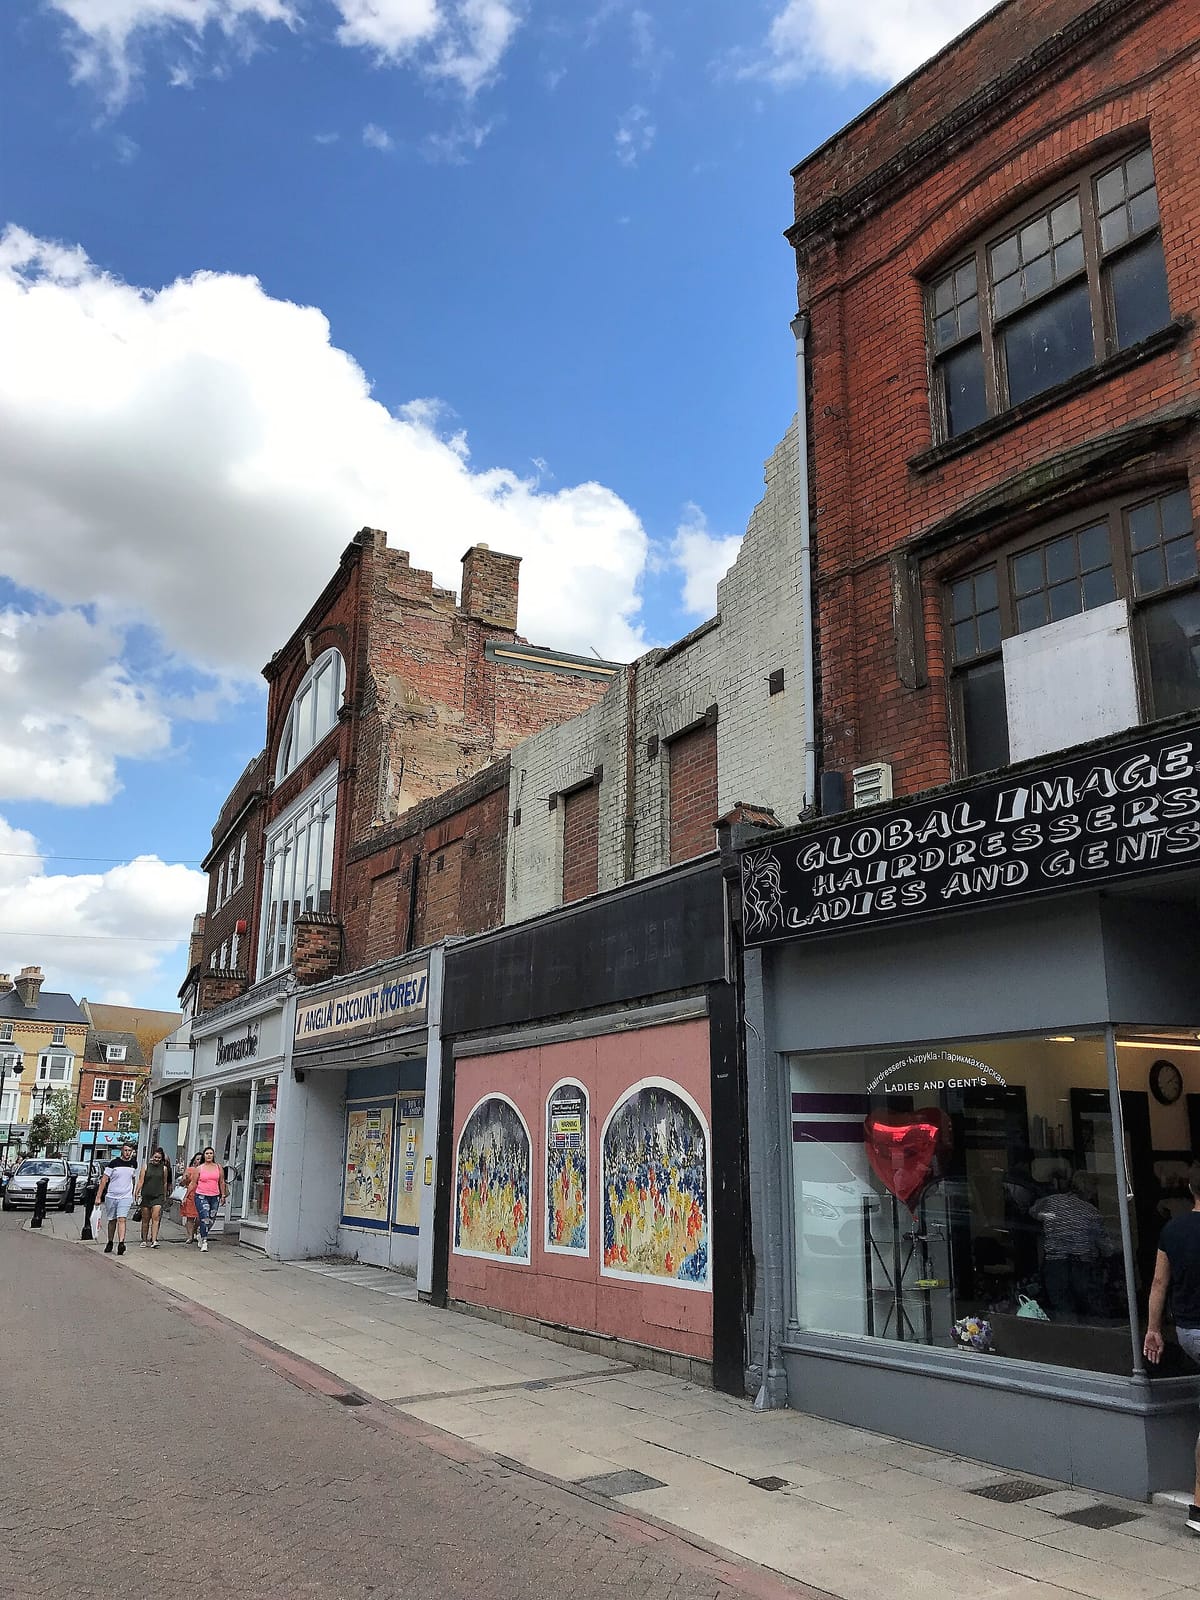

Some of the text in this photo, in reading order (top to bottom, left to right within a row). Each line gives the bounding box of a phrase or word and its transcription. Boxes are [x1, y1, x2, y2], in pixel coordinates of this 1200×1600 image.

[797, 802, 986, 872] GLOBAL
[812, 787, 1200, 896] HAIRDRESSER'S
[787, 820, 1200, 928] LADIES AND GENTS
[304, 978, 418, 1033] ANGLIA DISCOUNT STORES
[866, 1059, 907, 1093] Hairdressers
[941, 1051, 1006, 1086] Парикмахерская
